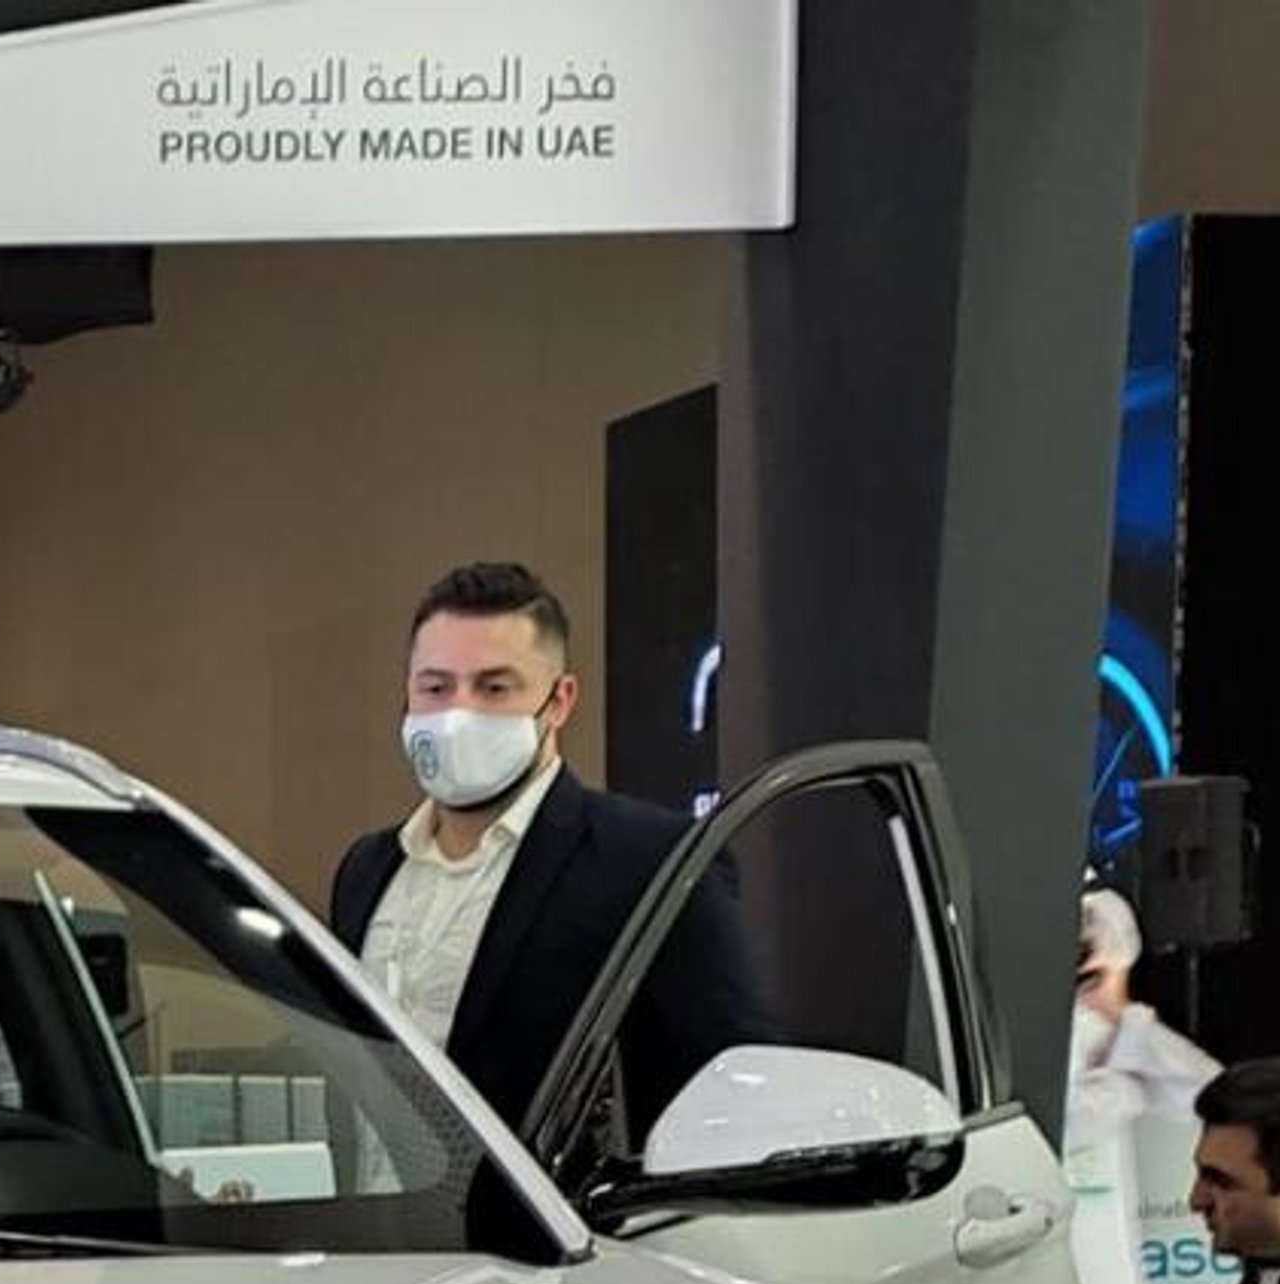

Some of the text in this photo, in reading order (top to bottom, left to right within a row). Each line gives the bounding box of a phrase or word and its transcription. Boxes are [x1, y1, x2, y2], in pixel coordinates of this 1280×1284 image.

[156, 56, 616, 120] فخر الصناعة الإماراتية
[159, 124, 616, 163] PROUDLY MADE IN UAE
